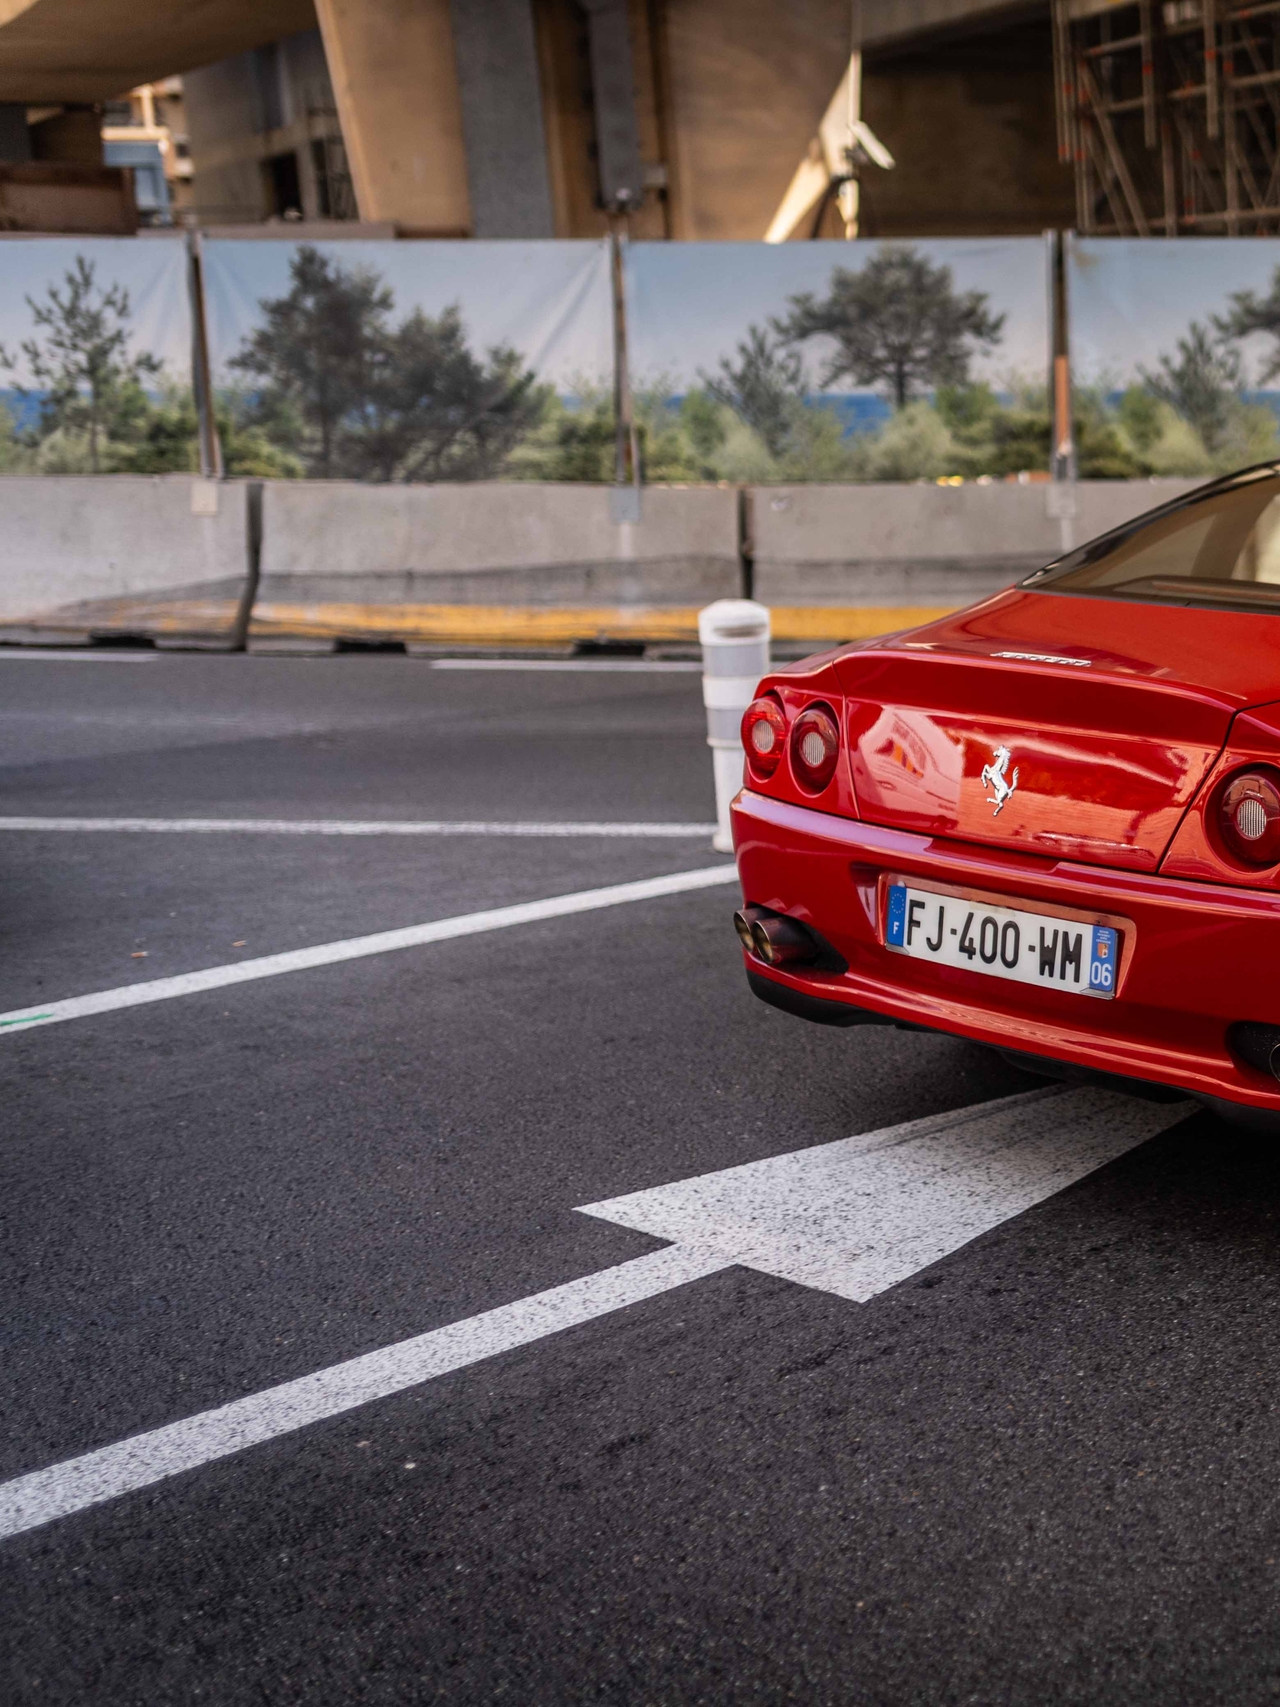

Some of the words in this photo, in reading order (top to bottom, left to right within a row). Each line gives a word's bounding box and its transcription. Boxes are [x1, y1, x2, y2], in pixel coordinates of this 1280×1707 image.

[892, 921, 900, 934] F
[907, 899, 1082, 983] FJ-400-WM
[1091, 962, 1113, 987] 06
